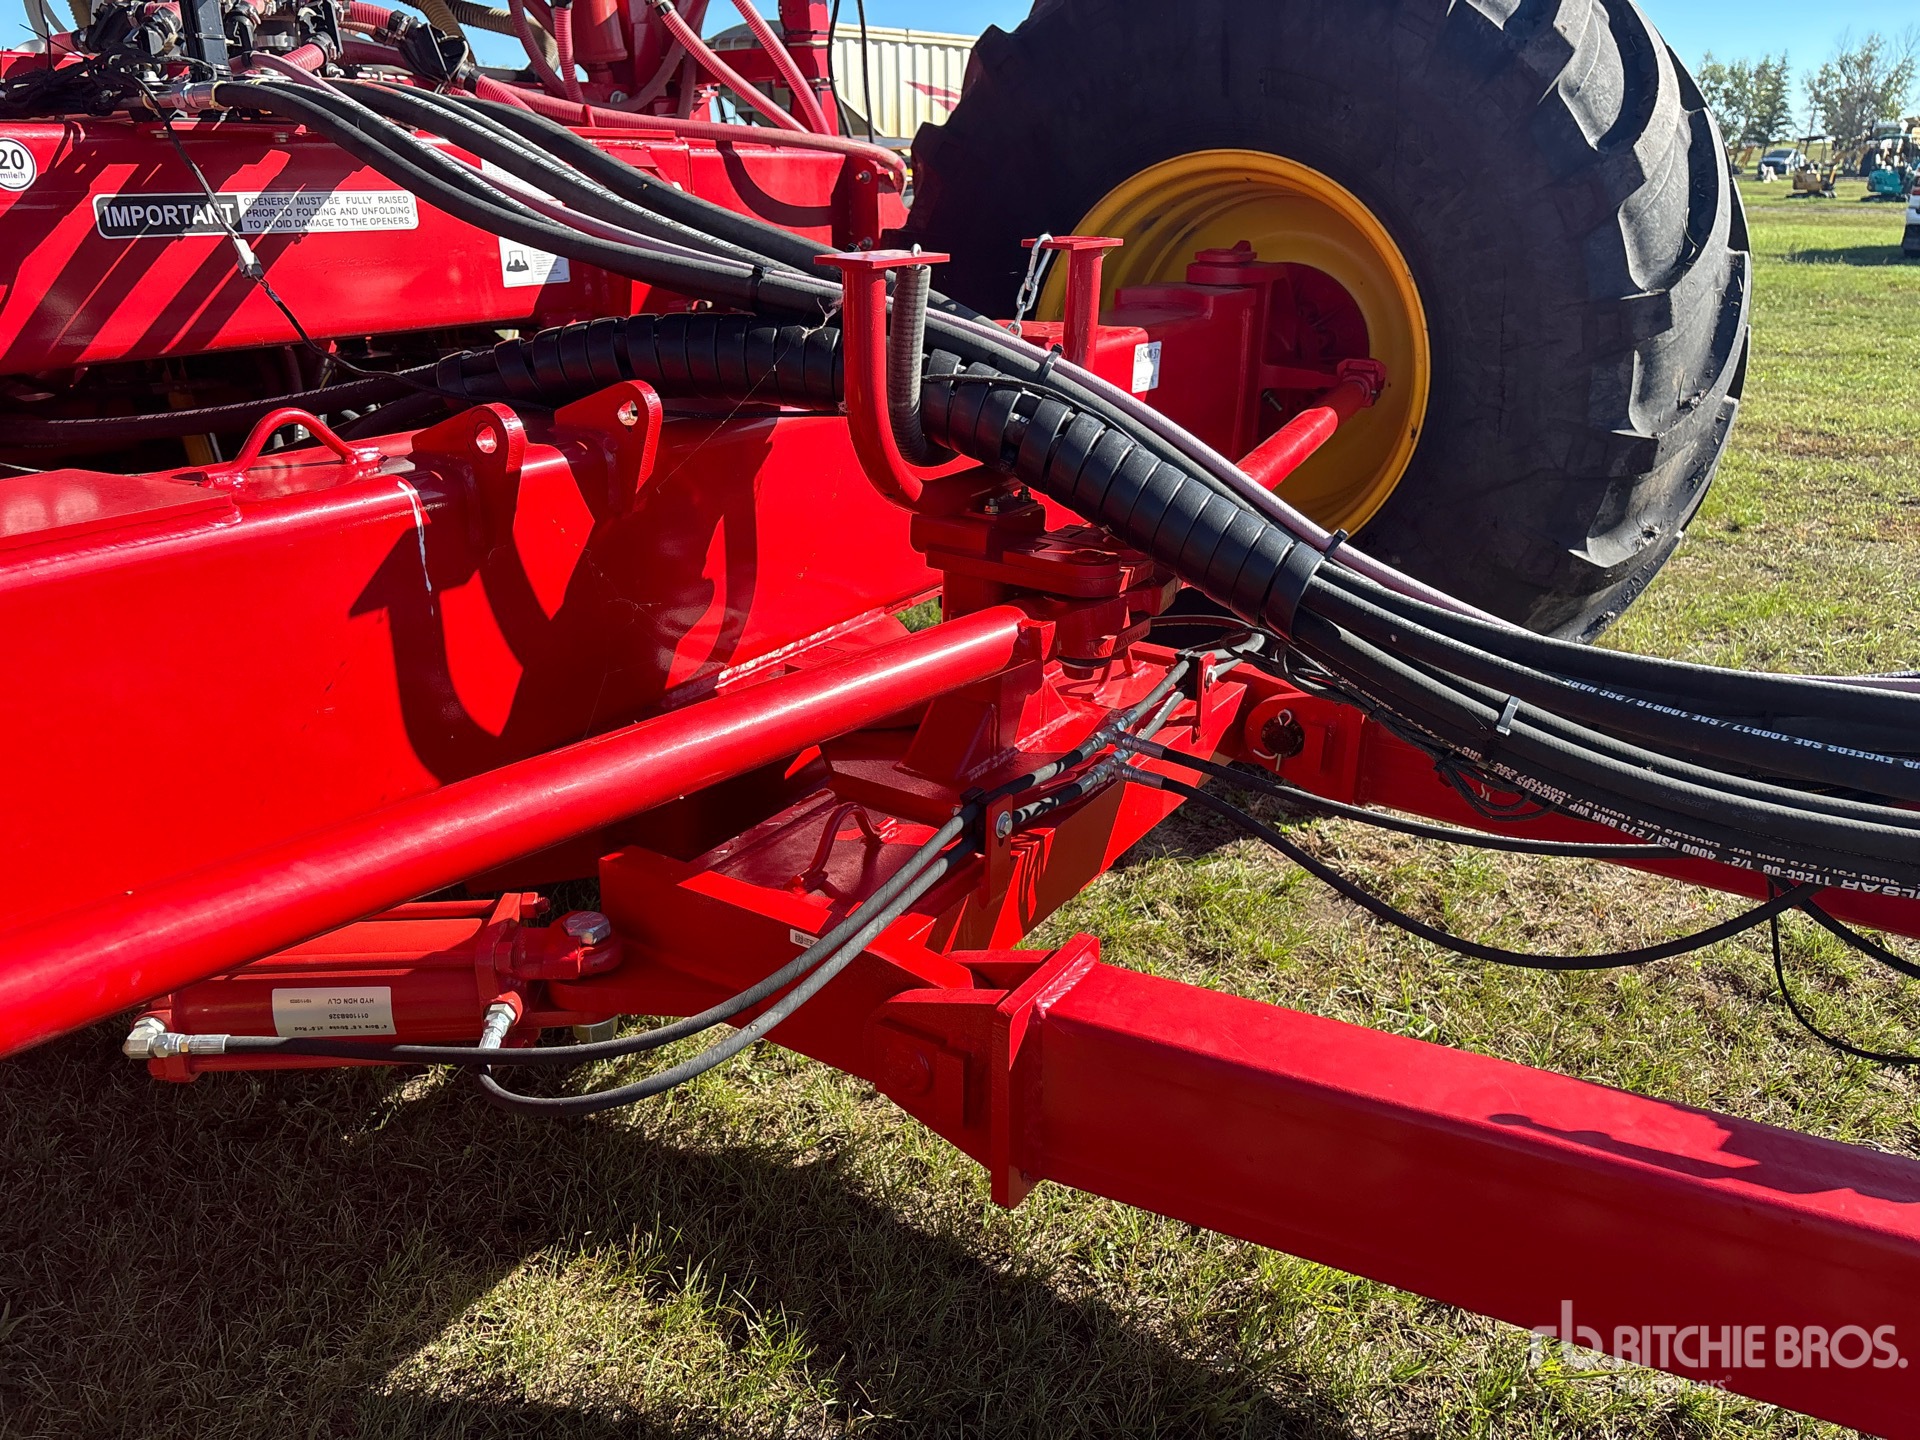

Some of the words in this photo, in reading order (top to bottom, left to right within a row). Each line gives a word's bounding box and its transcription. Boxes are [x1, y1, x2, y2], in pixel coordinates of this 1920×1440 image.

[0, 149, 24, 170] 20
[244, 197, 290, 206] OPENERS
[296, 197, 321, 205] MUST
[329, 196, 340, 205] BE
[346, 196, 372, 204] FULLY
[378, 195, 409, 204] RAISED
[104, 203, 234, 227] IMPORTANT
[246, 209, 276, 218] PRIOR
[279, 209, 292, 217] TO
[296, 208, 337, 217] FOLDING
[340, 207, 358, 216] AND
[362, 206, 410, 215] UNFOLDING
[247, 220, 261, 229] TO
[264, 219, 292, 229] AVOID
[294, 218, 334, 228] DAMAGE
[337, 218, 348, 226] TO
[350, 217, 367, 226] THE
[370, 216, 412, 226] OPENERS.
[1514, 775, 1564, 805] EXCEEDS
[1567, 800, 1590, 816] WP
[1590, 810, 1618, 828] BAR
[1619, 821, 1645, 838] 275
[1656, 834, 1679, 849] PSI
[1680, 842, 1717, 860] 4000
[1762, 863, 1832, 886] 112CC-08
